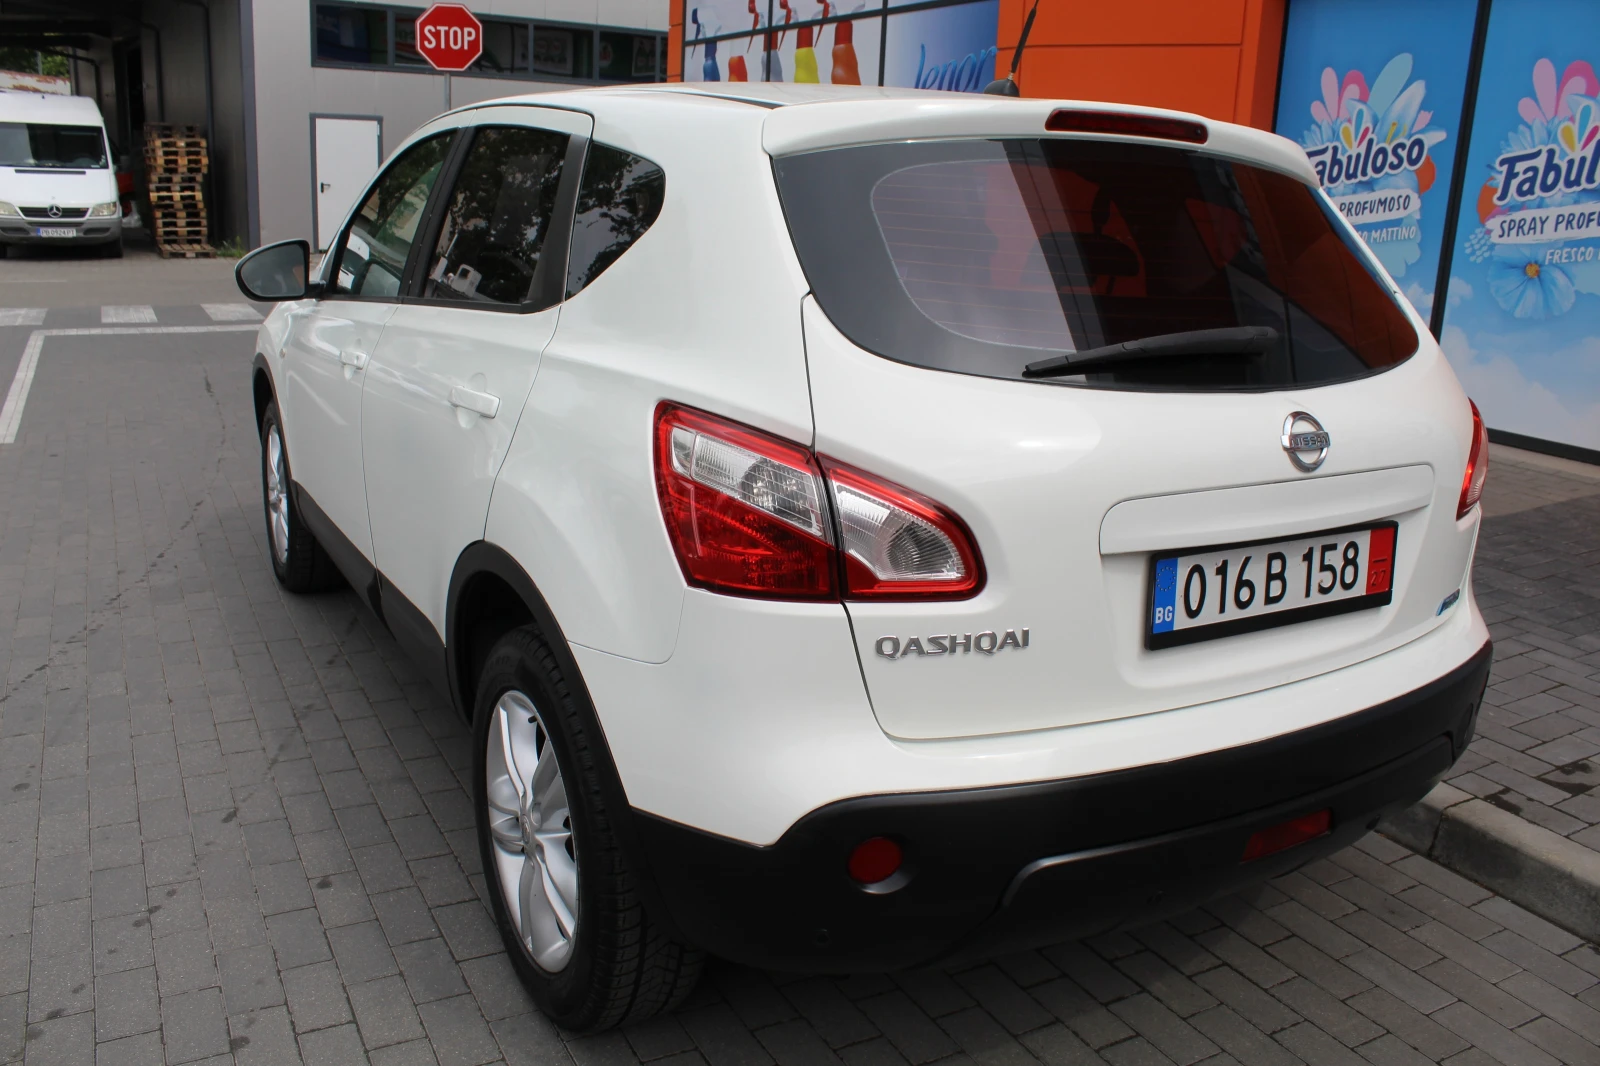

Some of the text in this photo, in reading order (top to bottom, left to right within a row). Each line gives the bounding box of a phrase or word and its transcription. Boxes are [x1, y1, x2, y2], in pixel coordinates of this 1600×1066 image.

[424, 25, 476, 50] STOP
[1340, 194, 1411, 218] PROFUMOSO
[1370, 226, 1416, 243] MATTINO
[1499, 211, 1600, 238] SPRAY PROF
[1545, 246, 1594, 265] FRESCO
[1291, 433, 1329, 448] NISSAN
[1184, 556, 1256, 619] 016
[1301, 540, 1359, 598] 158
[1371, 568, 1386, 587] 27
[1155, 605, 1173, 624] BG
[875, 627, 1030, 660] QASHQAI
